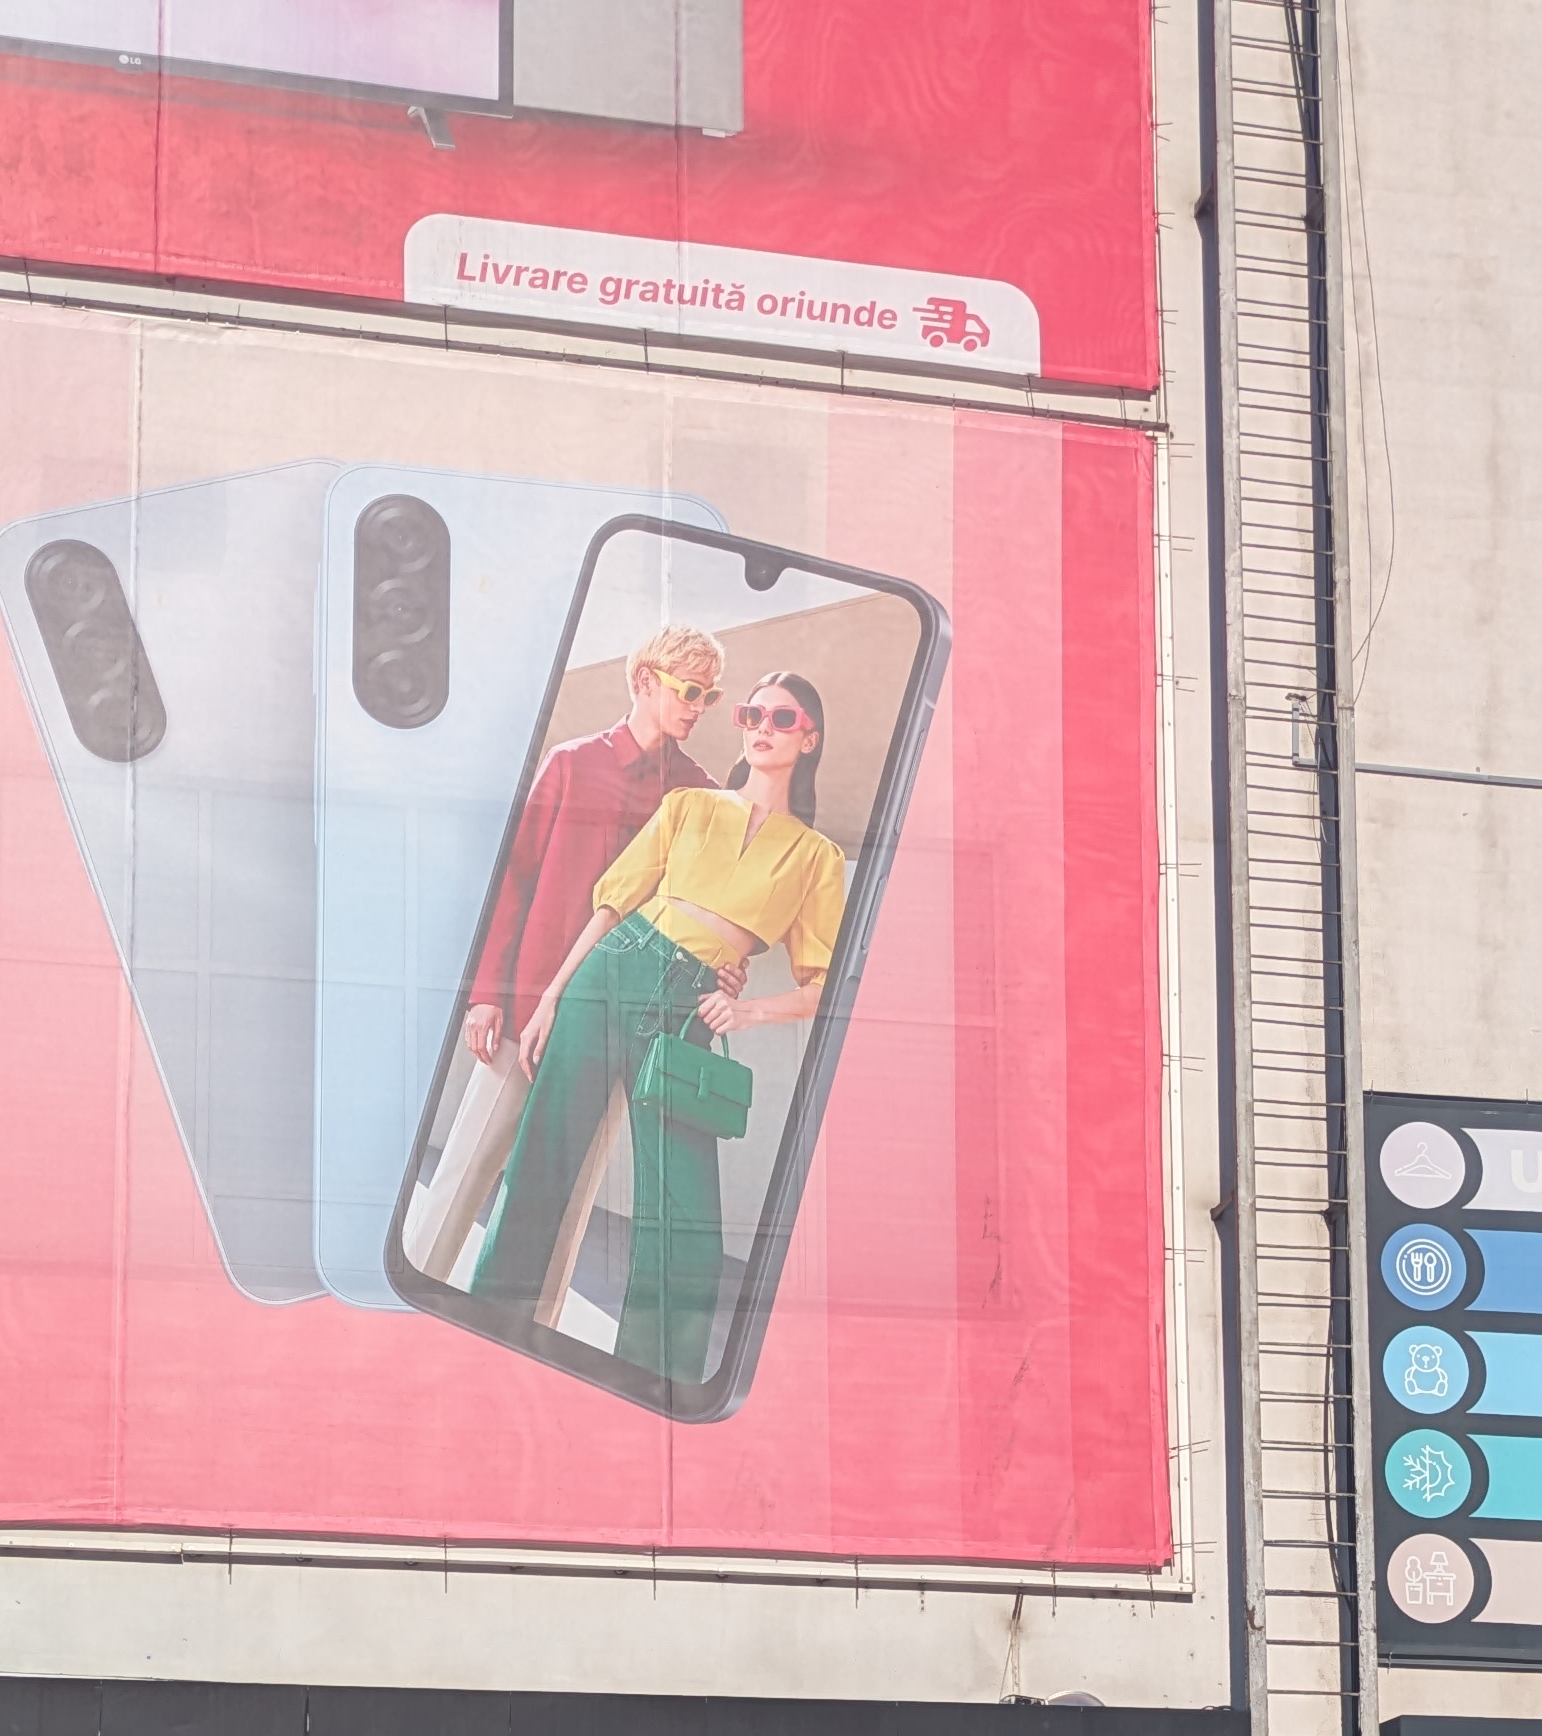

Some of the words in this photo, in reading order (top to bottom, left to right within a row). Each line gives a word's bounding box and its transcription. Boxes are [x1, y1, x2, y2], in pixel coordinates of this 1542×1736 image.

[457, 252, 588, 294] Livrare
[598, 276, 745, 312] gratuită
[756, 291, 898, 330] oriunde
